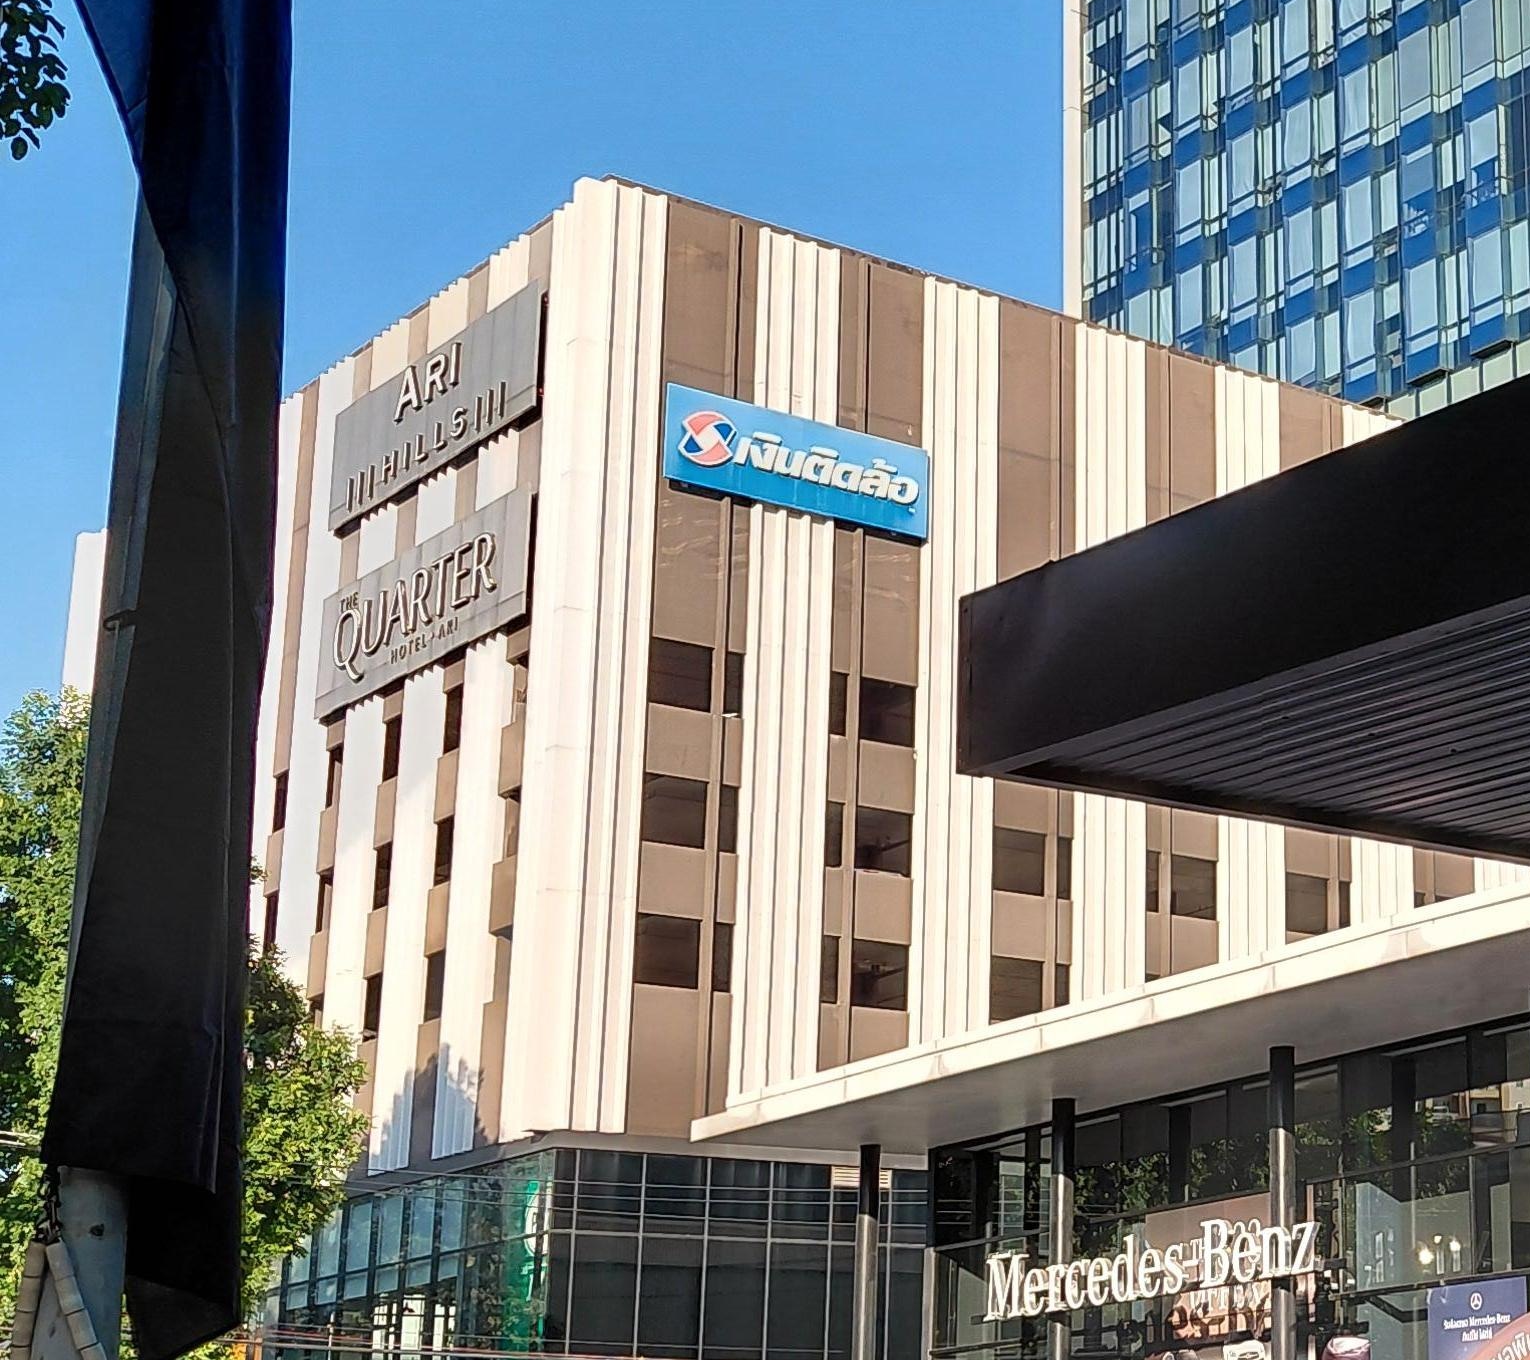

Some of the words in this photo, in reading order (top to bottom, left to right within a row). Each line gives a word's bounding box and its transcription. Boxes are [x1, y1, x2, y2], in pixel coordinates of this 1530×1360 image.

[394, 342, 462, 423] ARI
[382, 406, 468, 485] HILLS
[734, 431, 920, 506] เงินติดล้อ
[334, 532, 498, 684] QUARTER
[340, 591, 359, 613] THE
[391, 634, 428, 665] HOTEL
[983, 1219, 1322, 1322] Mercedes-Benz
